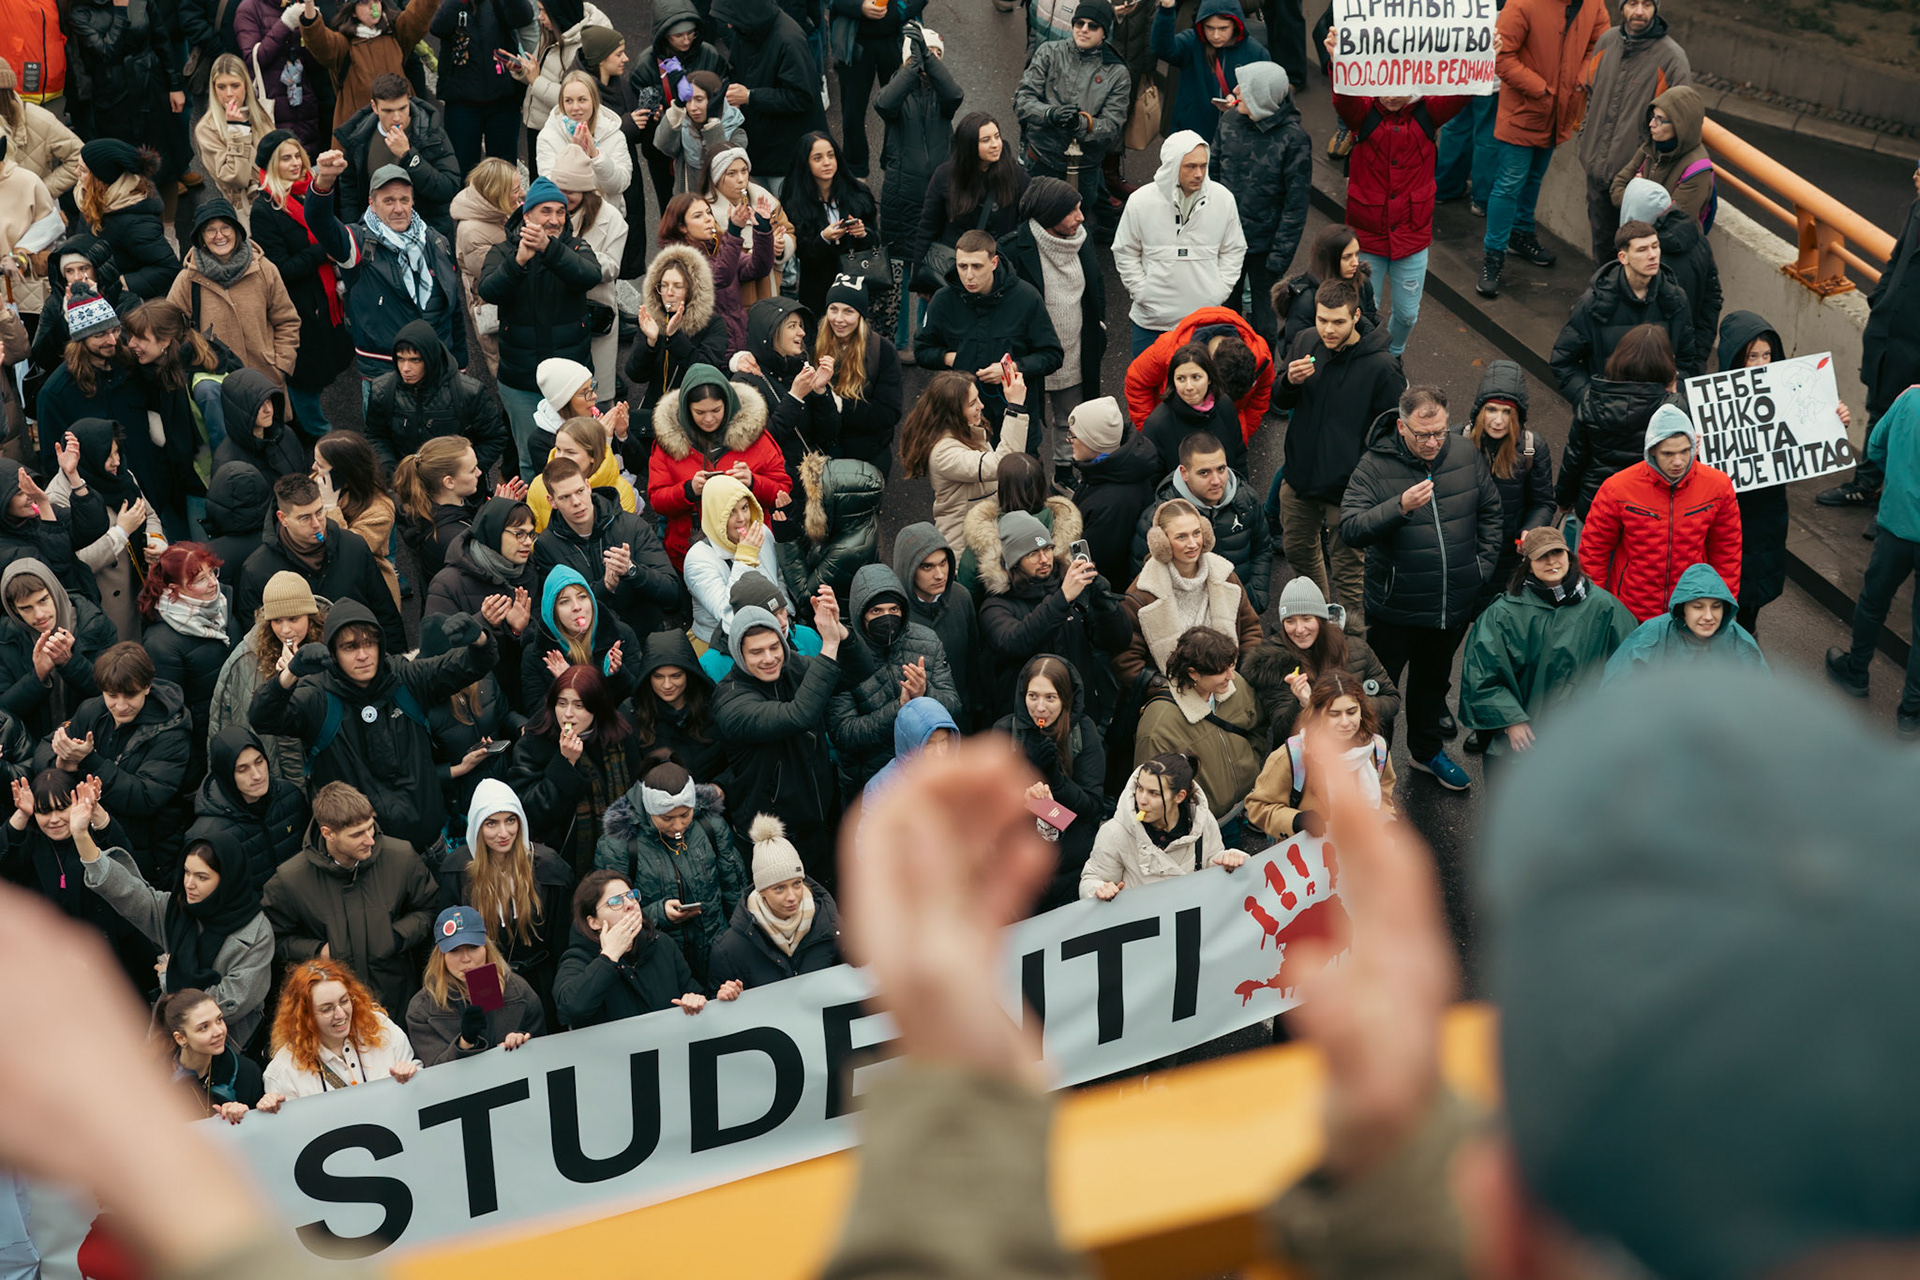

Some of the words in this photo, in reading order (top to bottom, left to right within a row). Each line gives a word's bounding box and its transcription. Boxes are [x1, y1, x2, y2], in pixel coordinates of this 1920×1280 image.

[1343, 0, 1456, 21] ДРЖАВА
[1462, 0, 1490, 19] ЈЕ
[1339, 25, 1492, 55] ВЛАСНИШТВО
[1698, 395, 1776, 434] НИКО
[1703, 421, 1799, 463] НИШТА
[1709, 453, 1768, 488] ИЈЕ
[1772, 437, 1854, 482] ПИТАО
[293, 905, 1201, 1262] STUDETI
